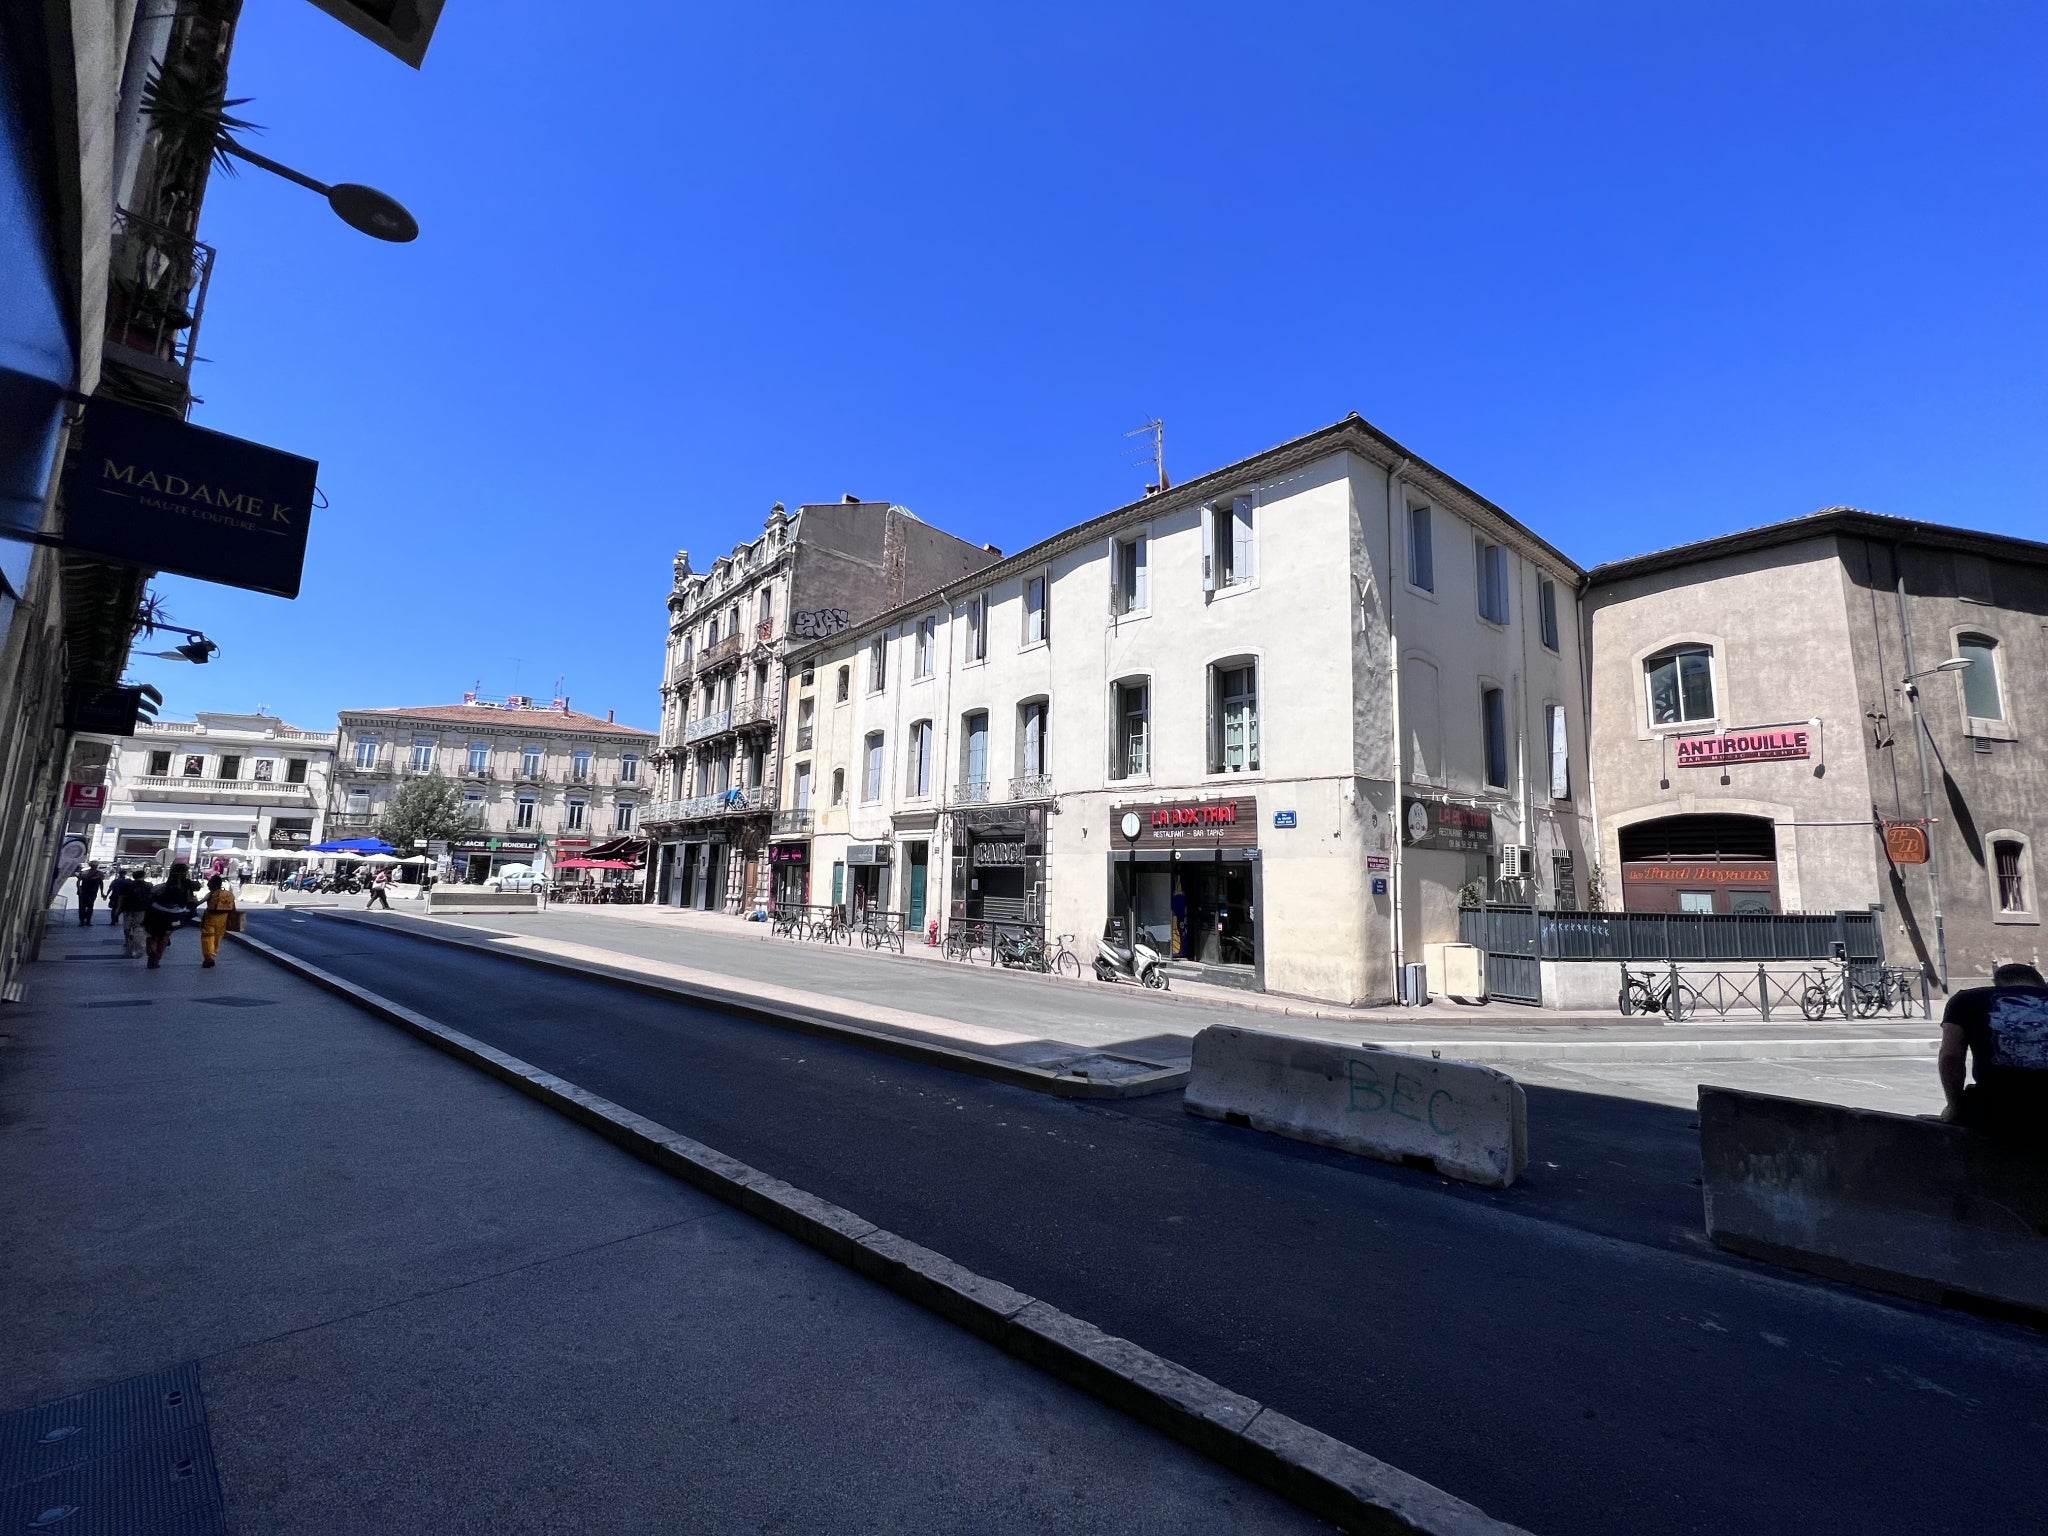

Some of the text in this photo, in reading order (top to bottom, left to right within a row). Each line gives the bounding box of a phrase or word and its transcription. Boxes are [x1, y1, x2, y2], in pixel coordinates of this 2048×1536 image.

[101, 458, 293, 525] MADAME K
[140, 496, 257, 532] HAUTE COUTURE
[1678, 733, 1807, 756] ANTIROUILLE
[1680, 756, 1701, 764] BAR
[1757, 748, 1804, 757] EVENTS
[1152, 809, 1169, 827] LA
[1172, 808, 1198, 825] BOX
[1153, 829, 1184, 838] RESTAURANT
[1193, 829, 1204, 837] BAR
[1206, 828, 1225, 836] TAPAS
[1348, 1058, 1458, 1136] BEC
